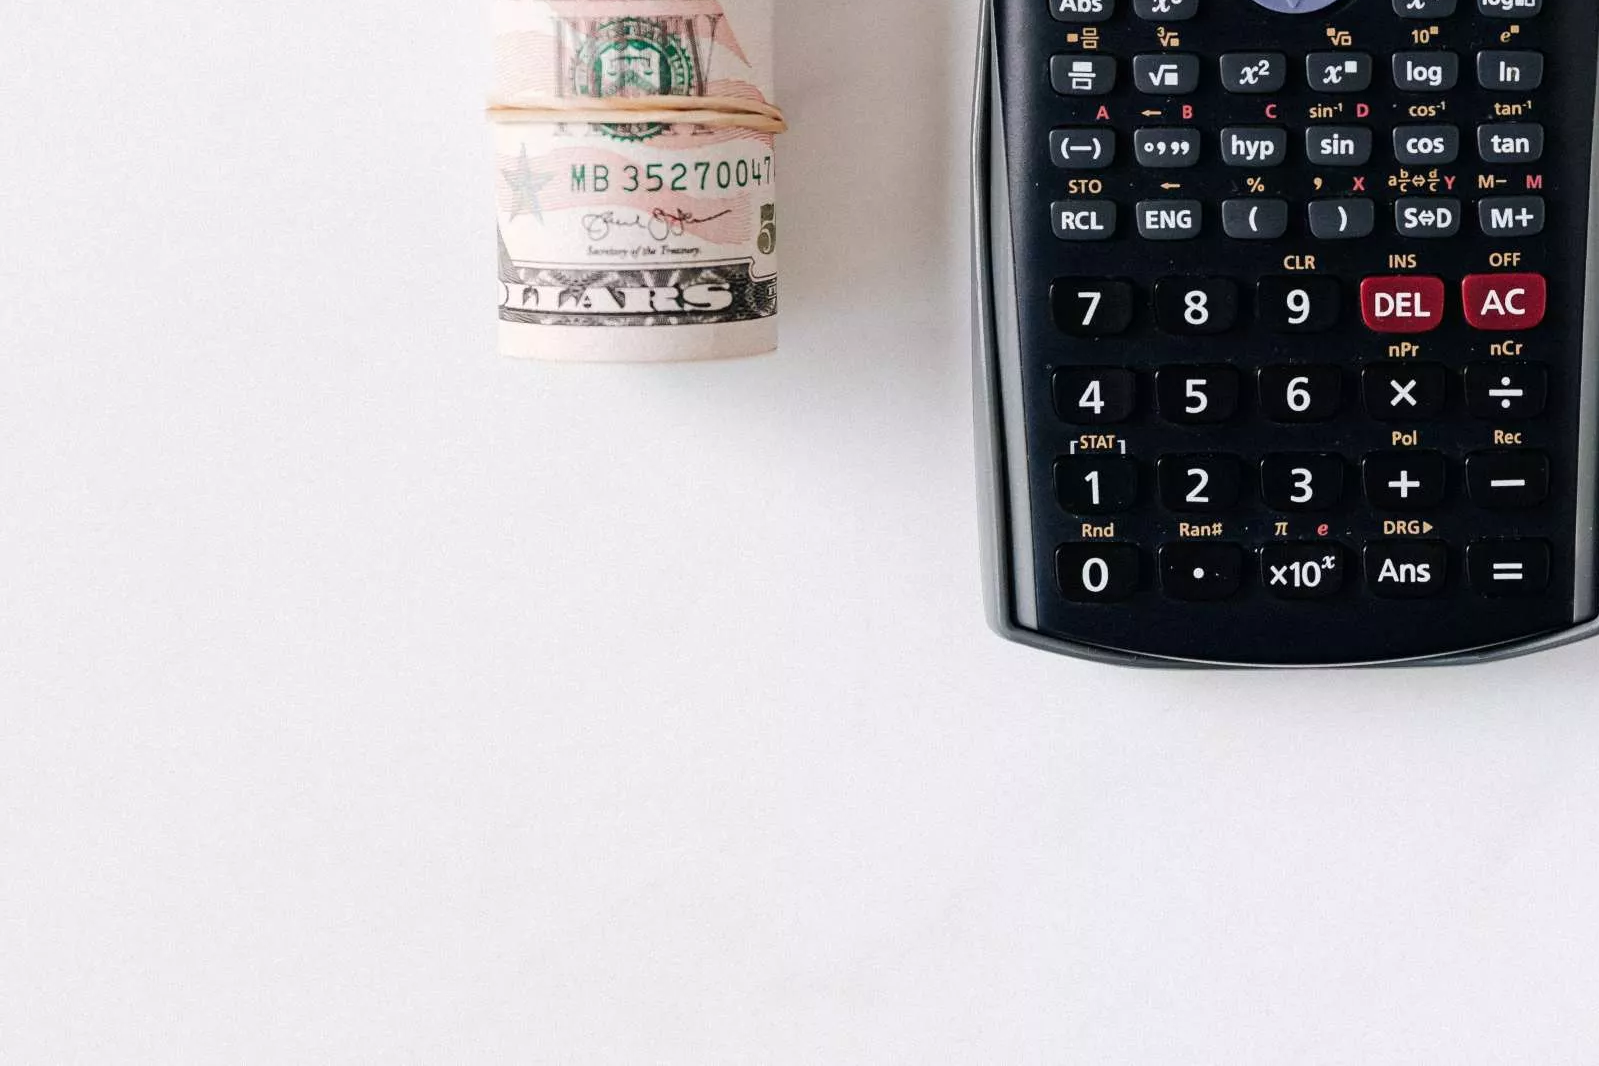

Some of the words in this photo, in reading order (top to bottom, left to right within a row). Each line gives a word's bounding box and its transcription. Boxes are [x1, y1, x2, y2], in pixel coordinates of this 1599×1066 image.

[1407, 61, 1442, 86] log
[1097, 106, 1109, 119] A
[1183, 105, 1192, 119] B
[1266, 104, 1276, 118] C
[1357, 104, 1368, 117] D
[1232, 135, 1274, 160] hyp
[1321, 134, 1354, 154] sin
[1407, 138, 1444, 153] cos
[1491, 135, 1529, 153] tan
[571, 163, 609, 193] MB
[1069, 180, 1101, 193] STO
[1247, 177, 1264, 192] %
[1353, 177, 1364, 190] X
[1444, 176, 1455, 189] Y
[1527, 175, 1542, 188] M
[1062, 212, 1103, 230] RCL
[1146, 210, 1191, 229] ENG
[1249, 207, 1257, 231] (
[1338, 206, 1347, 231] )
[1491, 208, 1533, 228] M+
[1284, 255, 1315, 269] CLR
[1389, 254, 1416, 268] INS
[1489, 253, 1520, 266] OFF
[1078, 292, 1101, 325] 7
[1184, 291, 1208, 324] 8
[1287, 290, 1309, 324] 9
[1375, 293, 1430, 317] DEL
[1481, 289, 1525, 316] AC
[1389, 342, 1419, 357] nPr
[1491, 341, 1522, 355] nCr
[1079, 381, 1104, 414] 4
[1186, 379, 1207, 413] 5
[1287, 377, 1310, 411] 6
[1080, 435, 1115, 449] STAT
[1392, 430, 1416, 445] Pol
[1495, 430, 1521, 444] Rec
[1085, 471, 1099, 504] 1
[1186, 469, 1208, 502] 2
[1291, 468, 1312, 502] 3
[1082, 523, 1113, 537] Rnd
[1180, 523, 1222, 536] Ran#
[1318, 524, 1328, 535] e
[1082, 558, 1108, 592] 0
[1378, 559, 1430, 582] Ans
